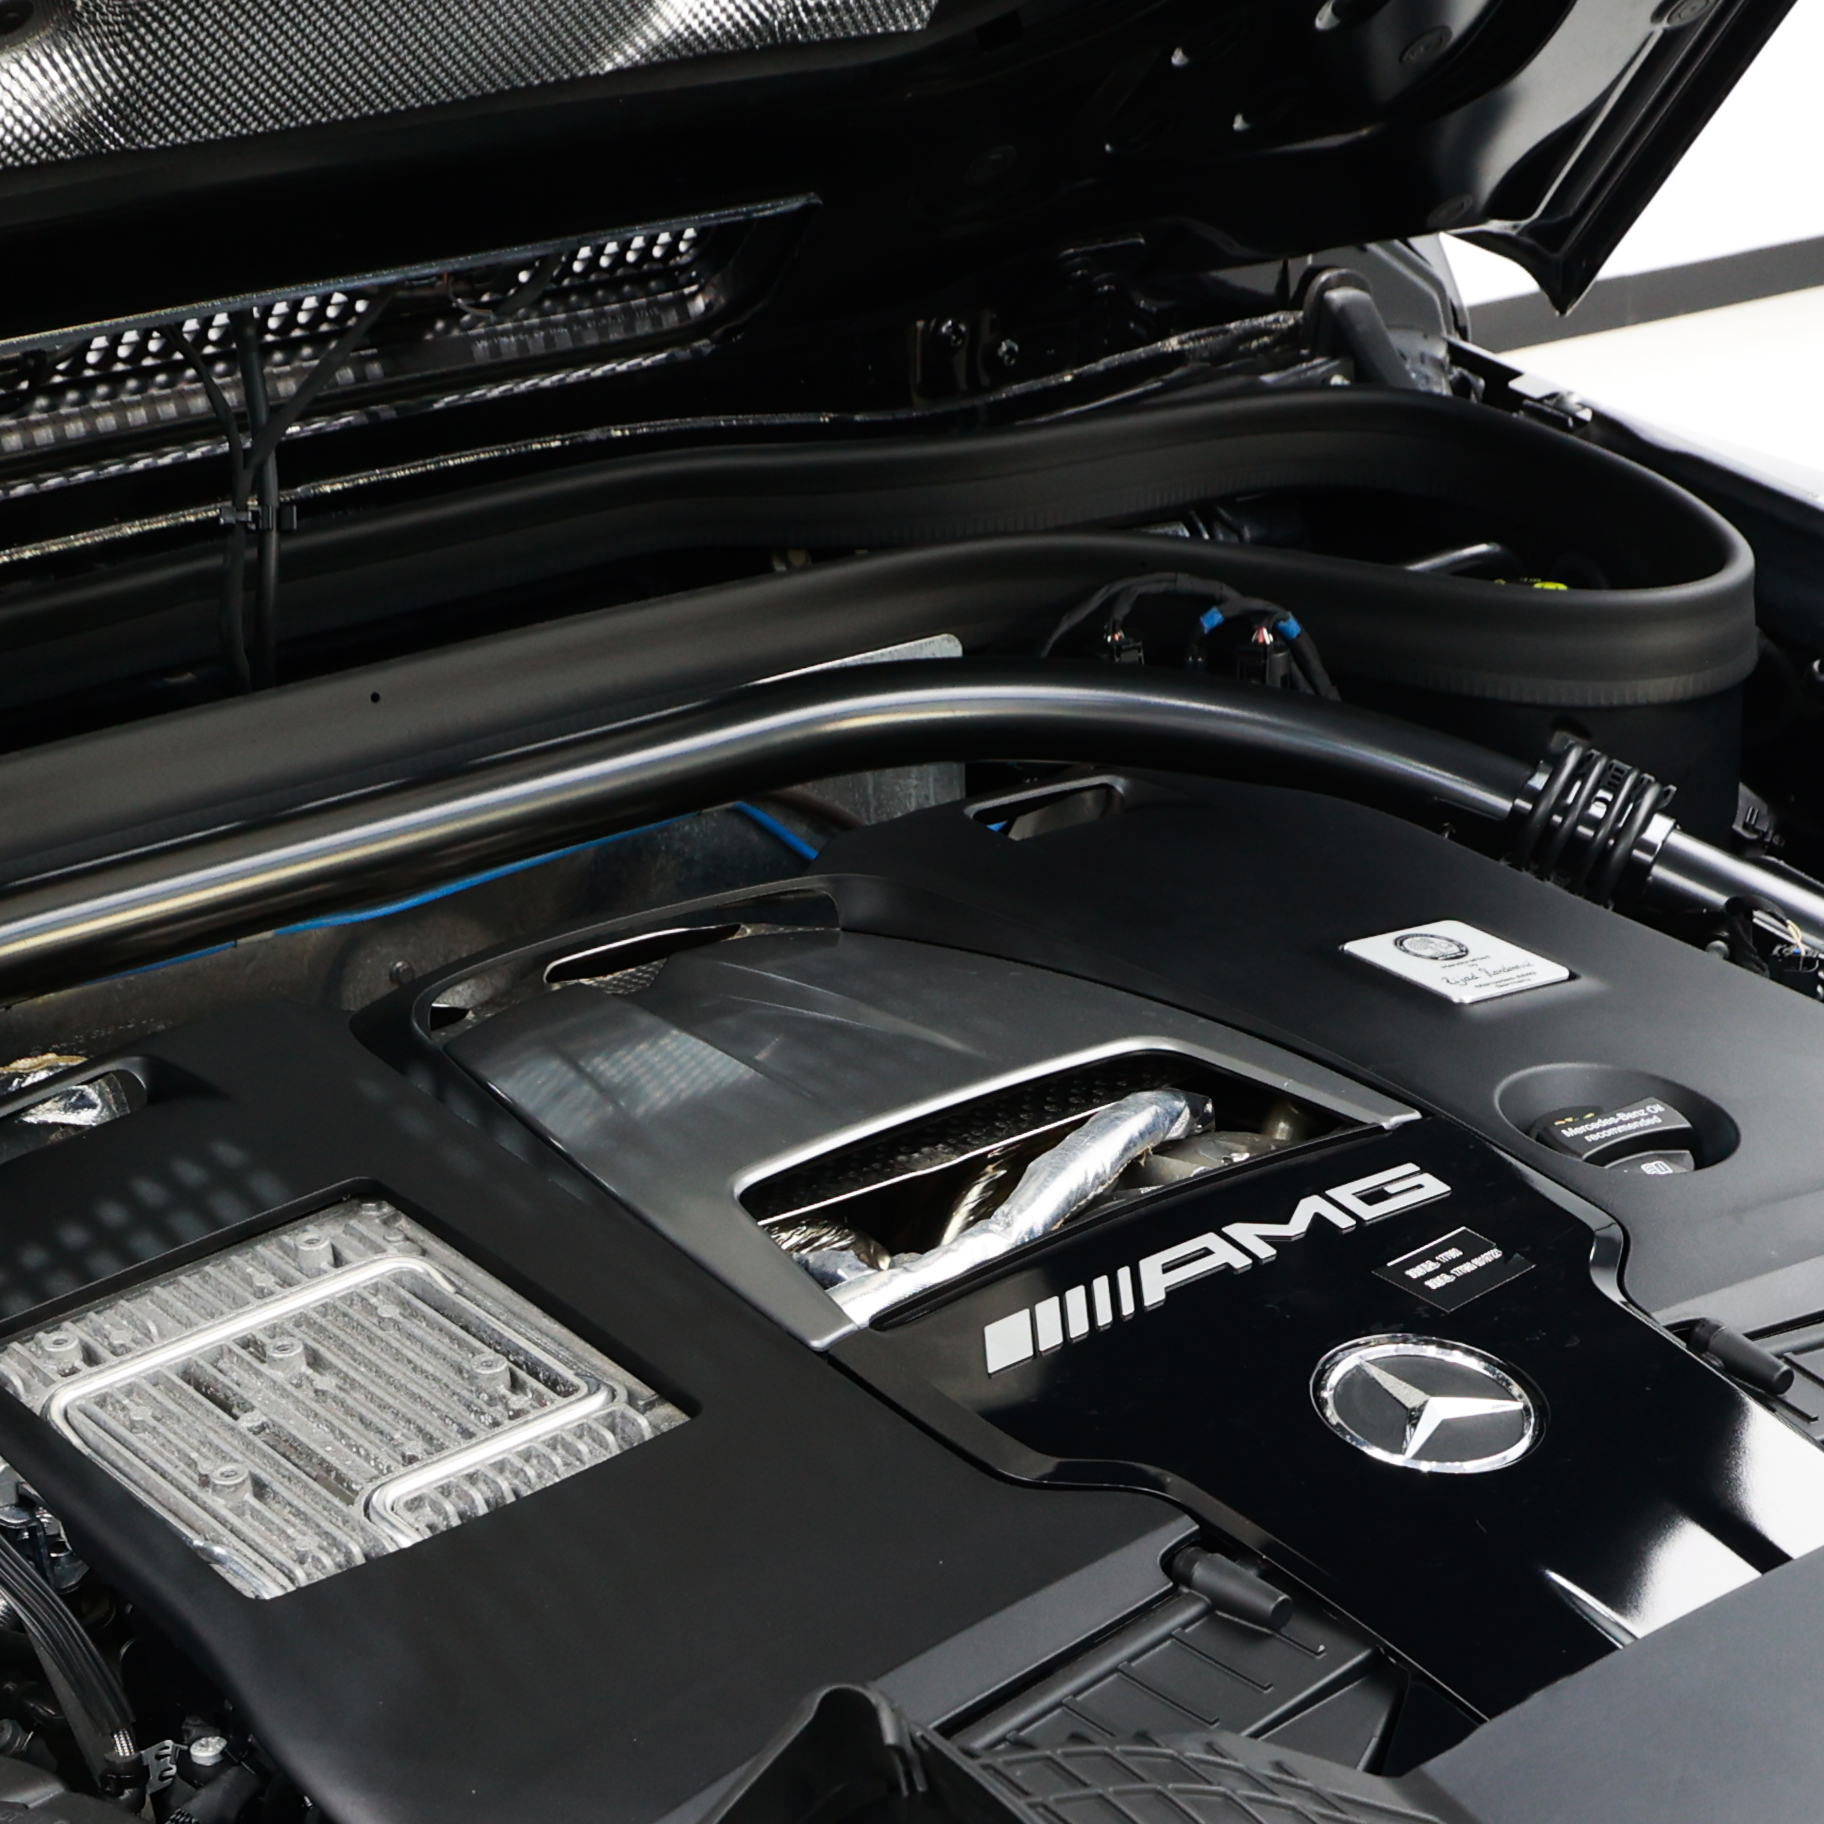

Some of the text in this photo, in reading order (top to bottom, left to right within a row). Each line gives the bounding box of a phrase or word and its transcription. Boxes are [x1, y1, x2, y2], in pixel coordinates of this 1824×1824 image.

[1561, 1109, 1648, 1138] Mercedes-Benz
[1647, 1103, 1665, 1115] Oil
[1584, 1115, 1663, 1142] recommended
[1141, 1161, 1451, 1307] AMG
